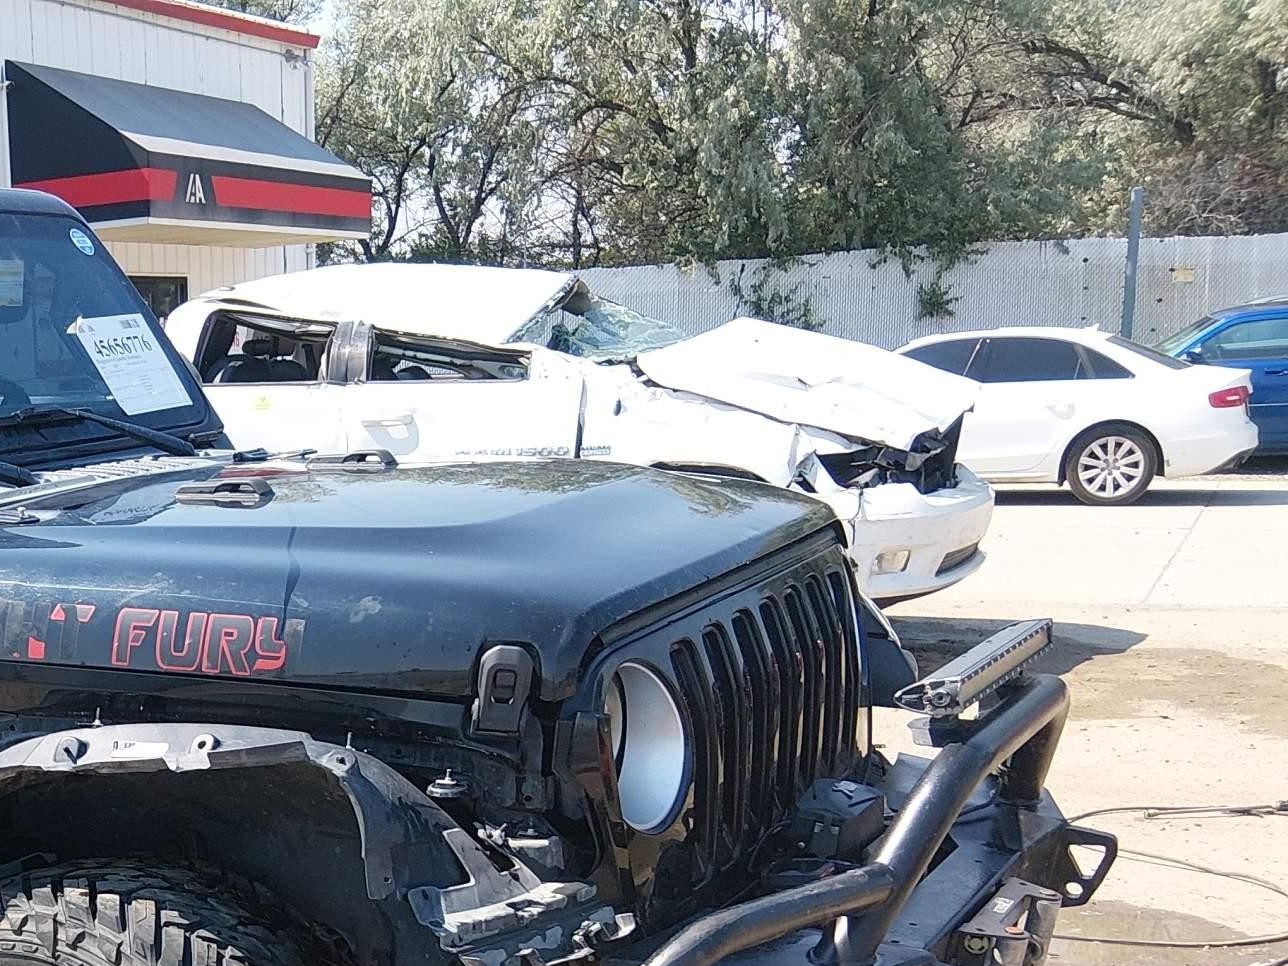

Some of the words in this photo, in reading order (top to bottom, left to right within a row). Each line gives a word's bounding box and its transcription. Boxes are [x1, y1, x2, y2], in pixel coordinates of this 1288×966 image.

[93, 334, 152, 357] 45656776
[516, 446, 569, 457] 1500
[111, 607, 304, 676] FURY
